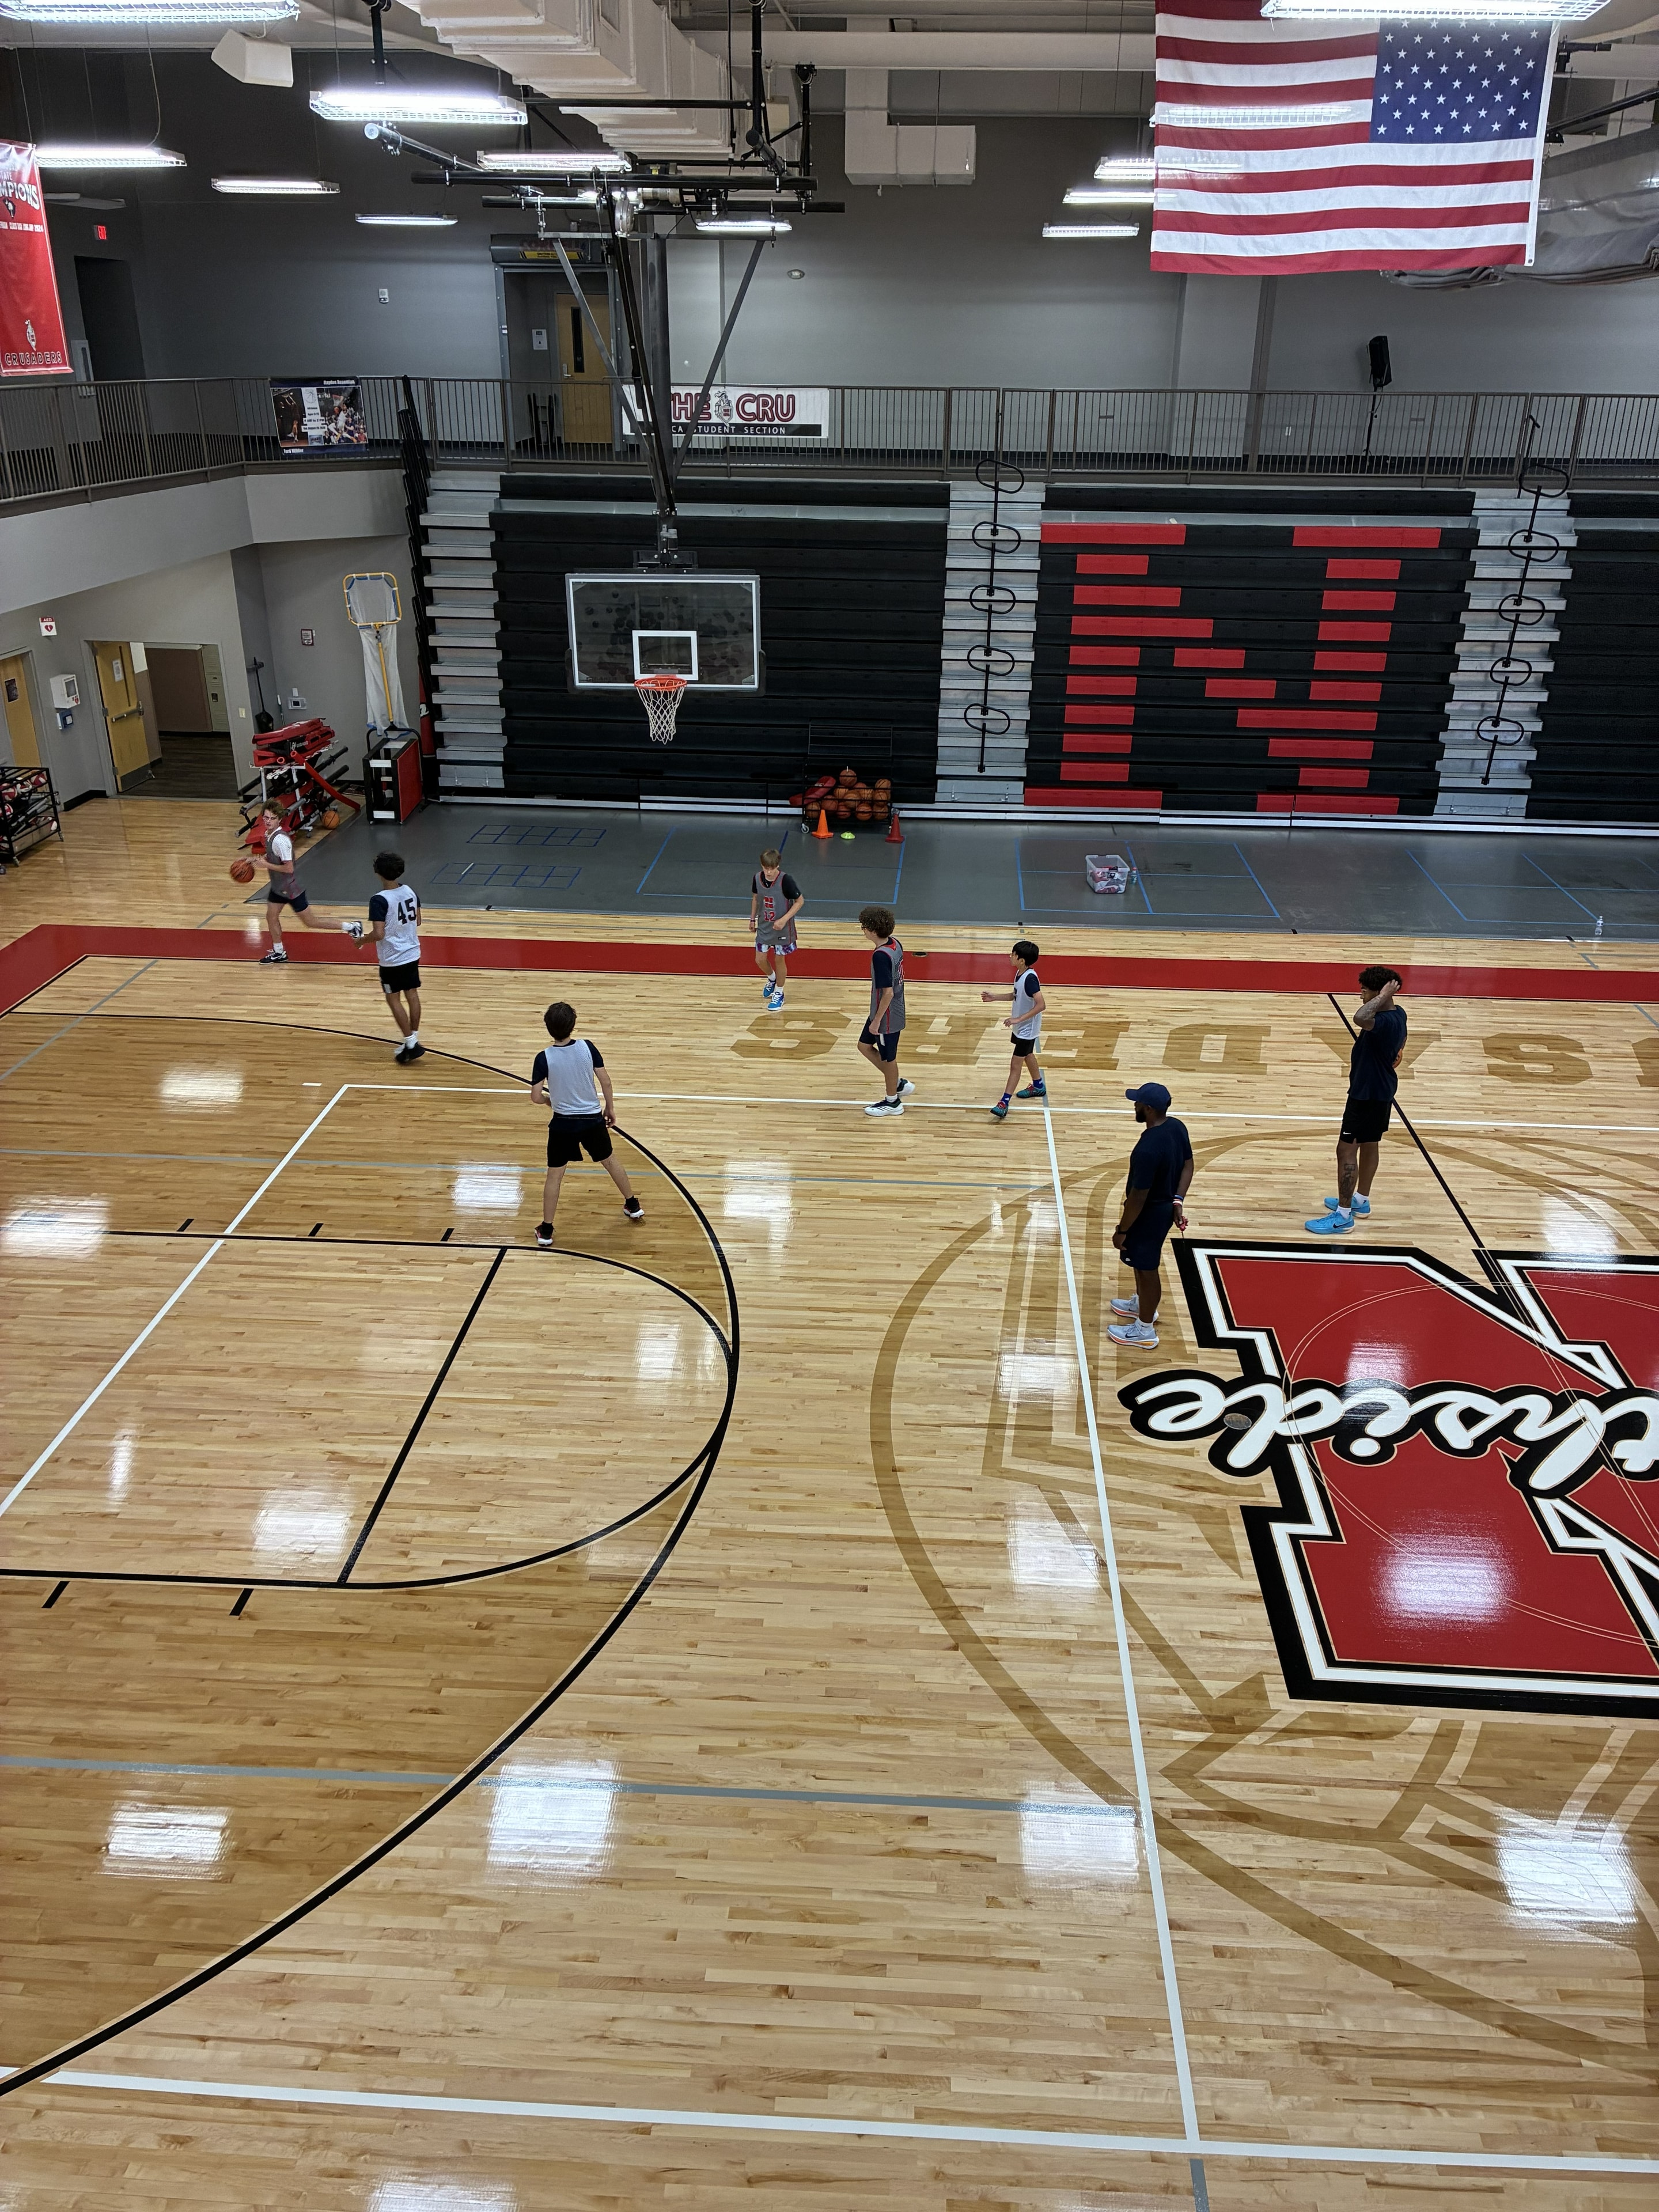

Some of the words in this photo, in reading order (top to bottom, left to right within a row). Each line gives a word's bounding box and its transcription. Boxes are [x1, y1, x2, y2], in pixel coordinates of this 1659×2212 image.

[5, 351, 62, 366] CRUSADERS
[736, 393, 796, 423] CRU
[693, 425, 736, 434] TUDENT
[744, 426, 786, 434] SECTION
[398, 898, 416, 925] 45
[764, 910, 777, 922] 12
